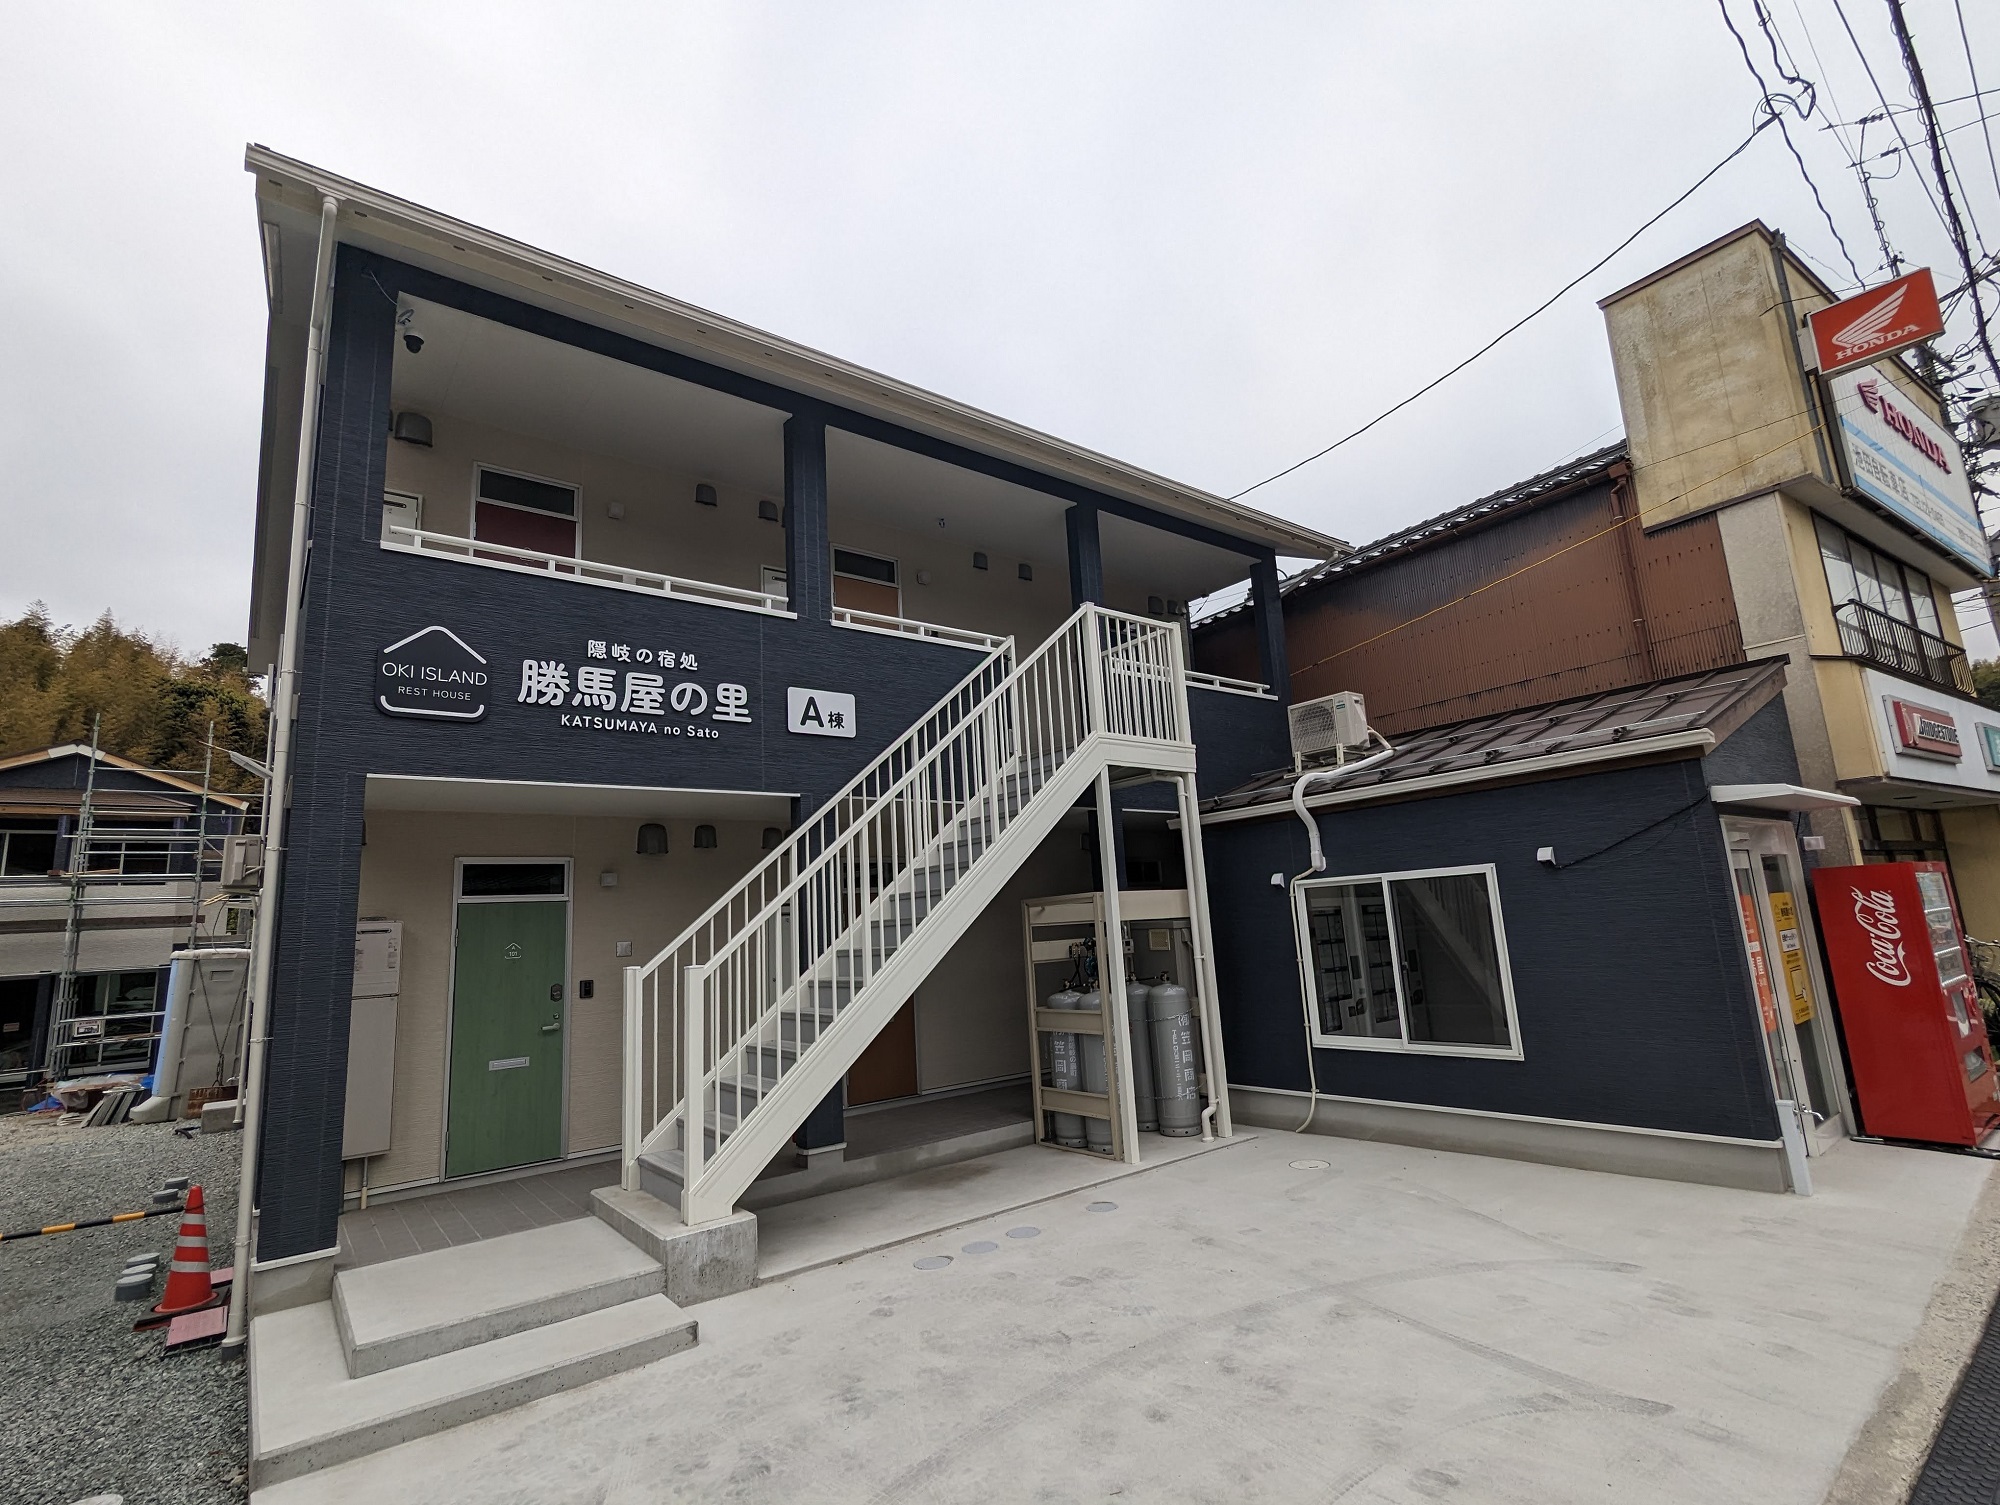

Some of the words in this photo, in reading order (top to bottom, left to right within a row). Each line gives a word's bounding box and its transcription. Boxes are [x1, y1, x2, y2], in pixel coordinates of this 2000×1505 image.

[1835, 324, 1920, 361] HONDA
[1879, 395, 1952, 475] HONDA
[587, 639, 699, 671] 隠岐の宿処
[382, 662, 414, 678] OKI
[421, 666, 488, 686] ISLAND
[397, 686, 428, 696] REST
[432, 690, 471, 701] HOUSE
[517, 659, 753, 724] 勝馬屋の里
[561, 714, 658, 734] KATSUMAYA
[664, 724, 681, 736] no
[687, 725, 720, 739] Sato
[1919, 716, 1960, 744] BRIDGESTONE
[1850, 885, 1912, 987] Coca-Cola
